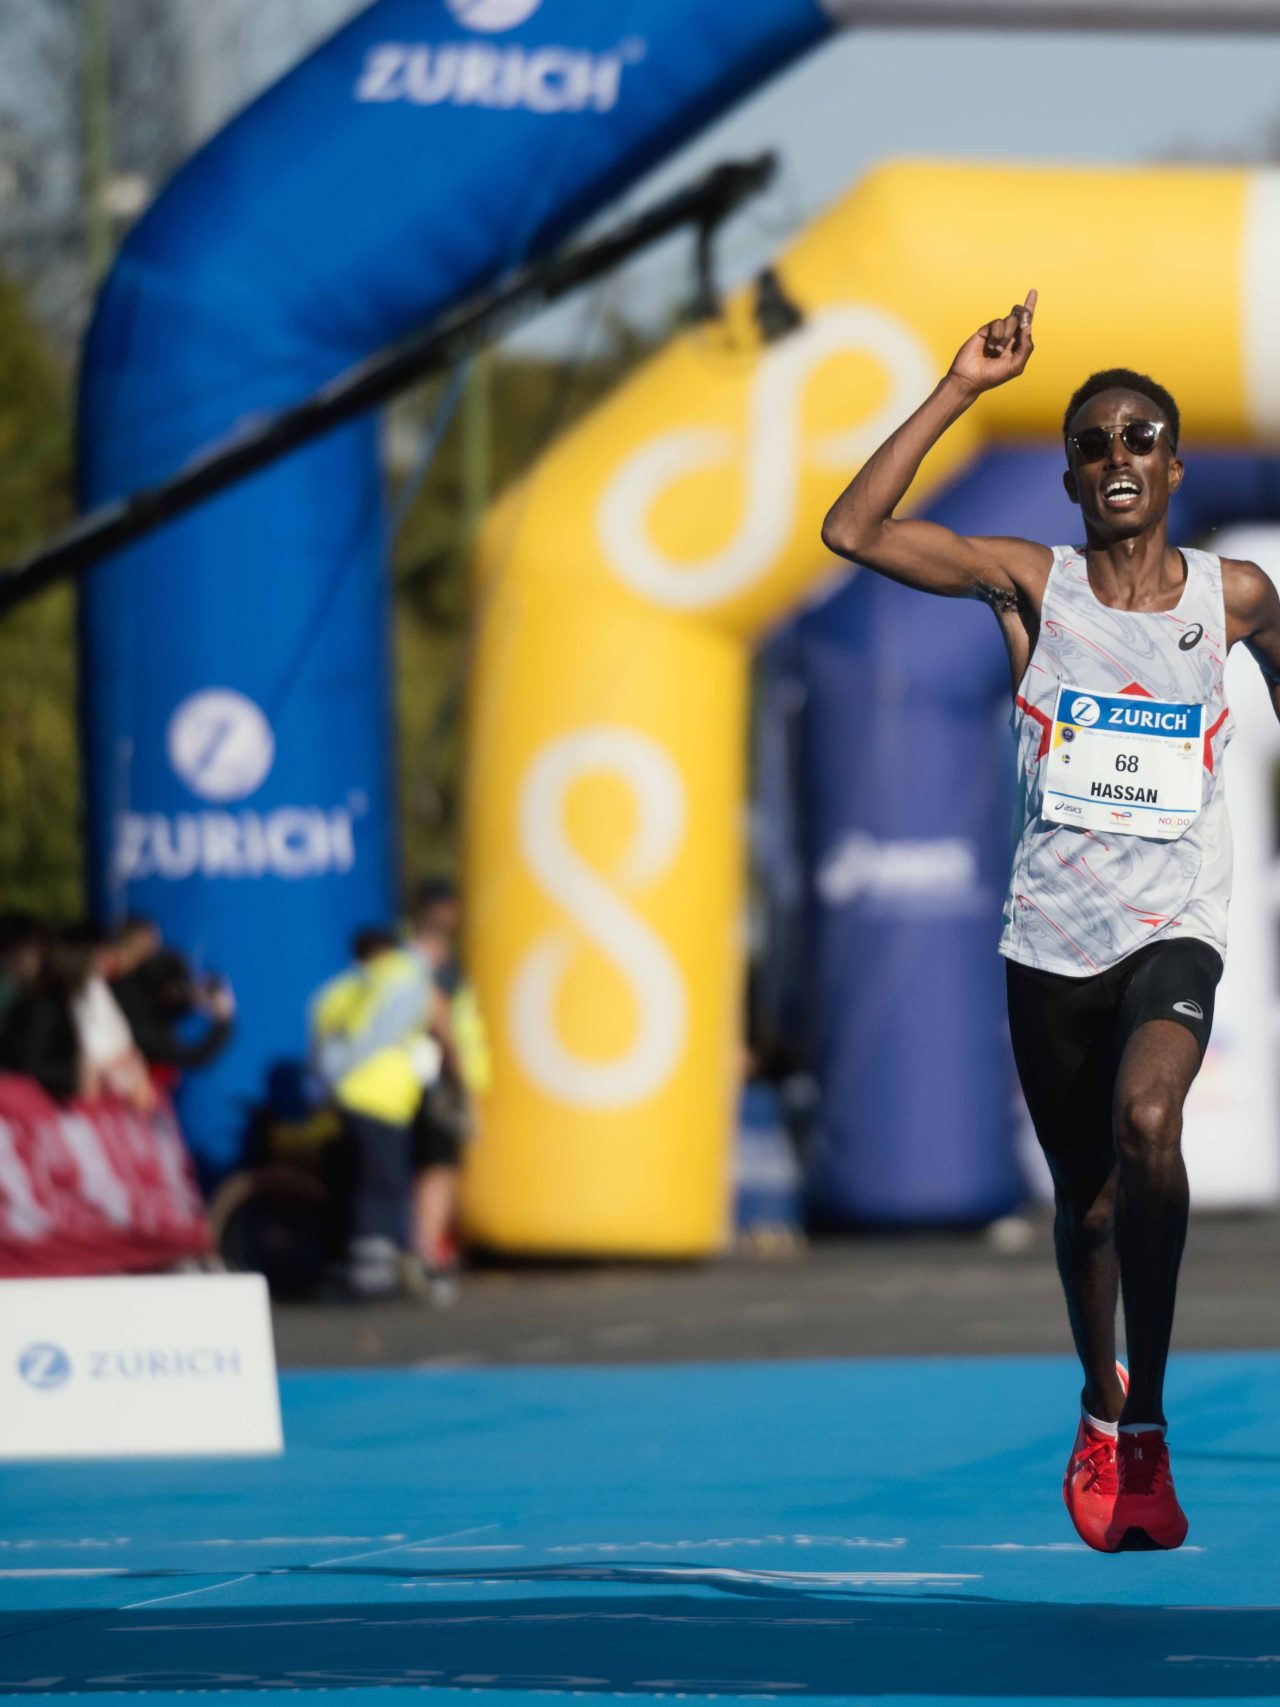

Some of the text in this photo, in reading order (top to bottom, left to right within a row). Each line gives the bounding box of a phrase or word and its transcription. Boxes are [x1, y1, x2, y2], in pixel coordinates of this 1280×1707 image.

[356, 42, 622, 113] ZURICH
[1108, 707, 1187, 730] ZURICH
[1115, 754, 1139, 773] 68
[1090, 782, 1158, 803] HASSAN
[112, 806, 355, 880] ZURICH
[88, 1349, 243, 1378] ZURICH
